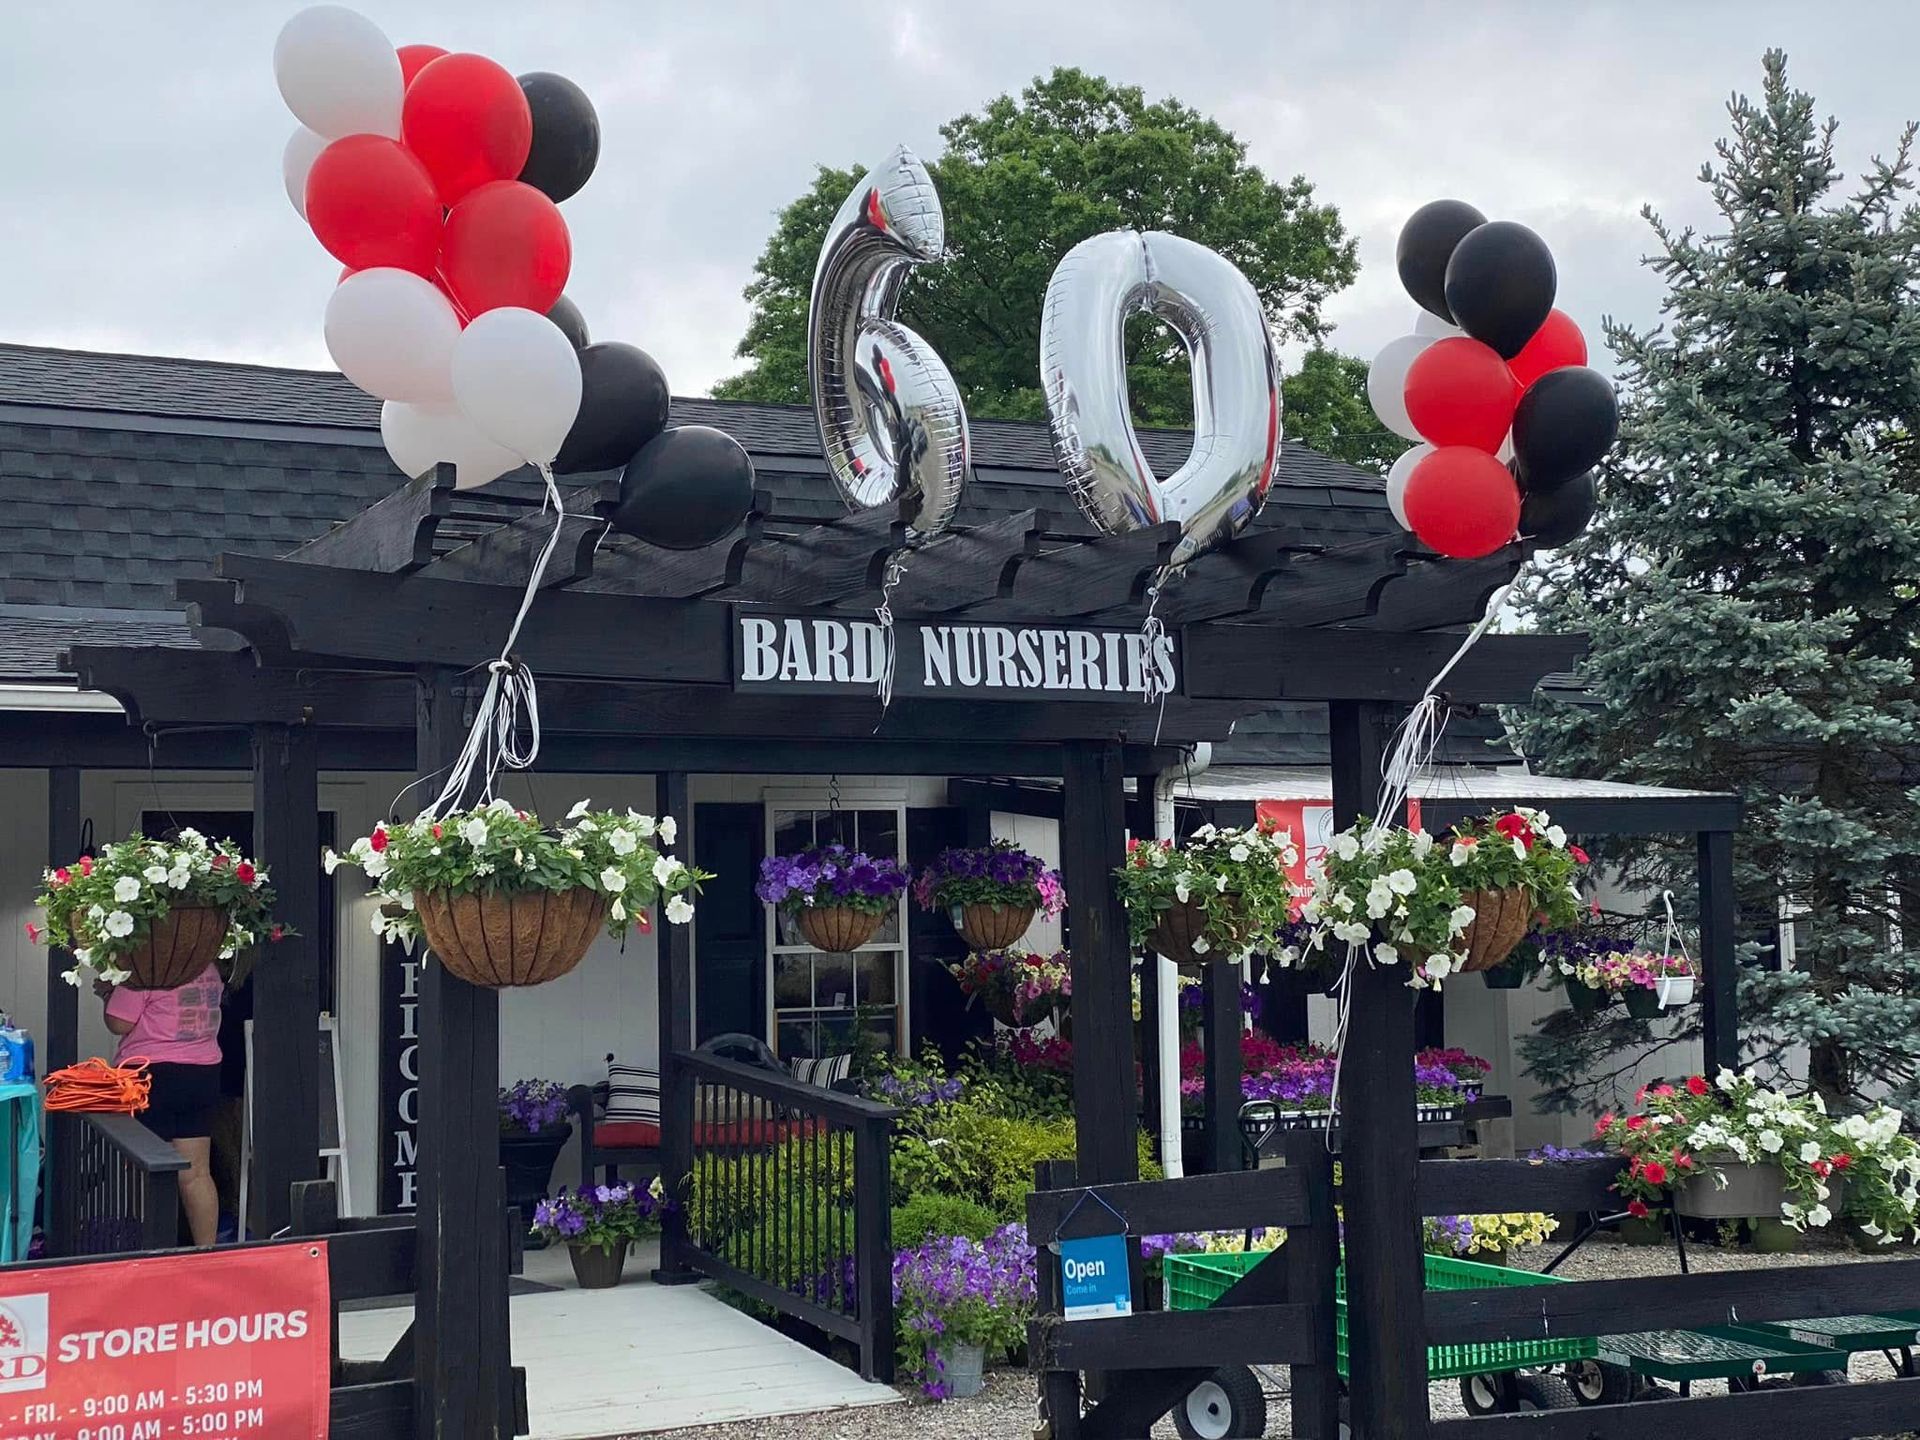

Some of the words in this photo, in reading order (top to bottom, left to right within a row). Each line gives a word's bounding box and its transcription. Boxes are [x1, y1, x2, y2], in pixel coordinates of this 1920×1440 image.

[740, 617, 886, 683] BARD
[919, 626, 1177, 694] NURSERIES
[1065, 1258, 1105, 1283] Open
[1066, 1284, 1088, 1296] Come
[1088, 1282, 1097, 1293] in
[57, 1323, 178, 1363] STORE
[185, 1309, 308, 1348] HOURS
[24, 1402, 62, 1424] FRI.
[83, 1394, 129, 1418] 9:00
[135, 1389, 165, 1411] AM
[185, 1382, 228, 1405] 5:30
[234, 1378, 263, 1400] PM
[132, 1418, 161, 1440] AM
[182, 1411, 228, 1435] 5:00
[234, 1407, 264, 1430] PM
